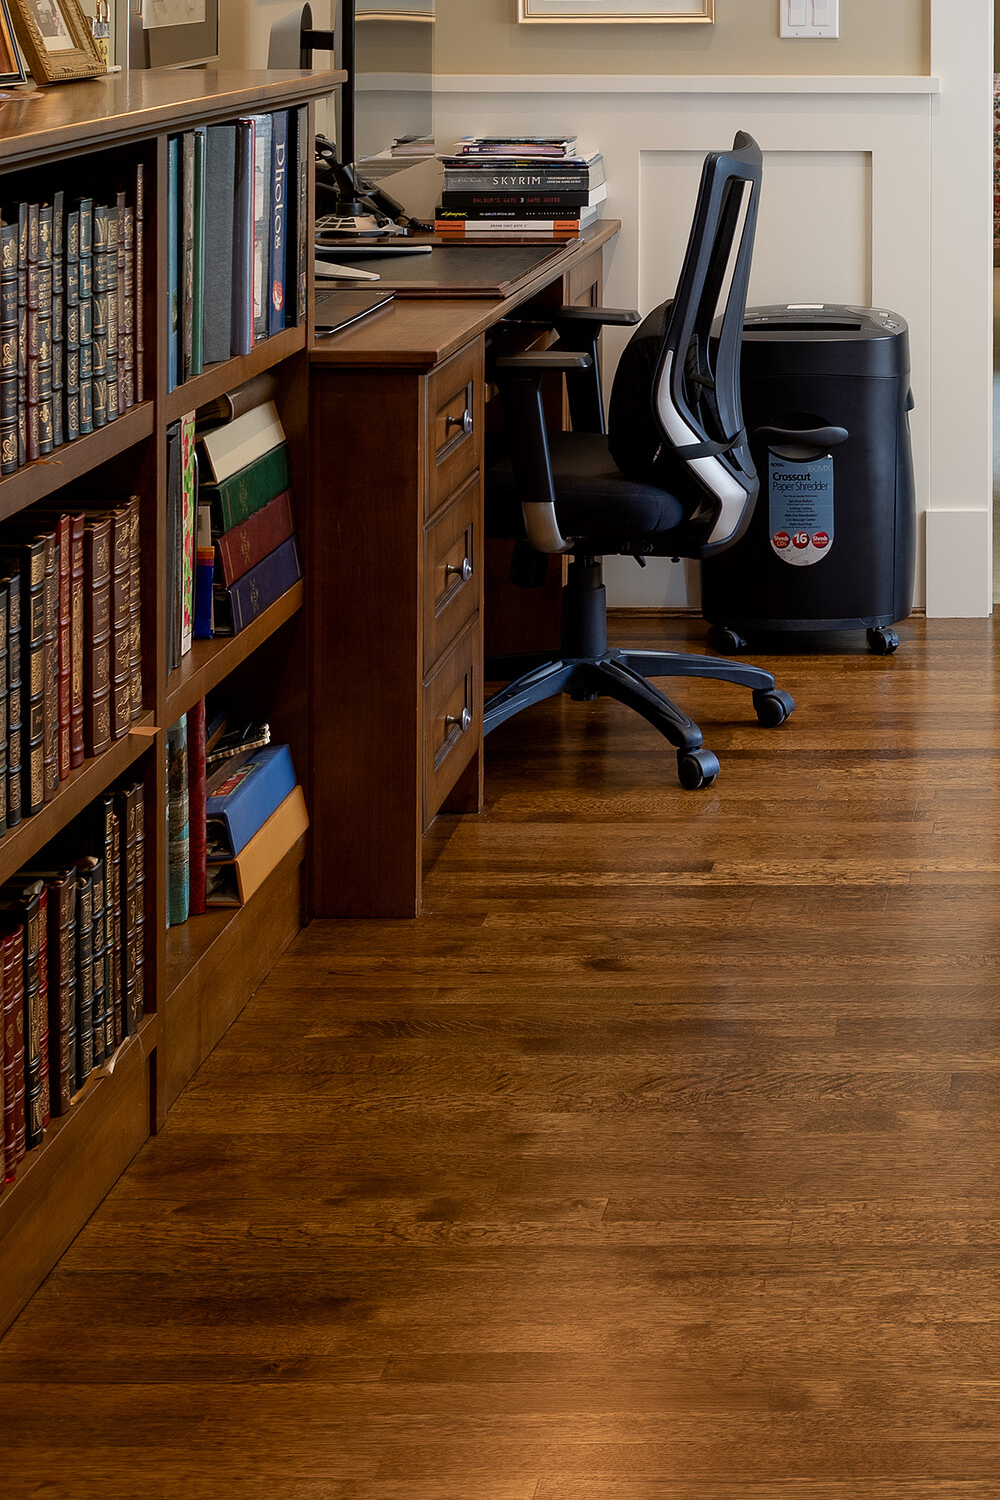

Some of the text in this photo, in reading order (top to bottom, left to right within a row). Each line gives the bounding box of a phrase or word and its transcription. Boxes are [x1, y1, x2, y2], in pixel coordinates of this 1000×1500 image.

[492, 176, 541, 185] SKYRIM
[274, 141, 285, 250] Photos
[772, 472, 811, 481] Crosscut
[772, 481, 829, 493] Paper Shredder
[793, 533, 808, 544] 16
